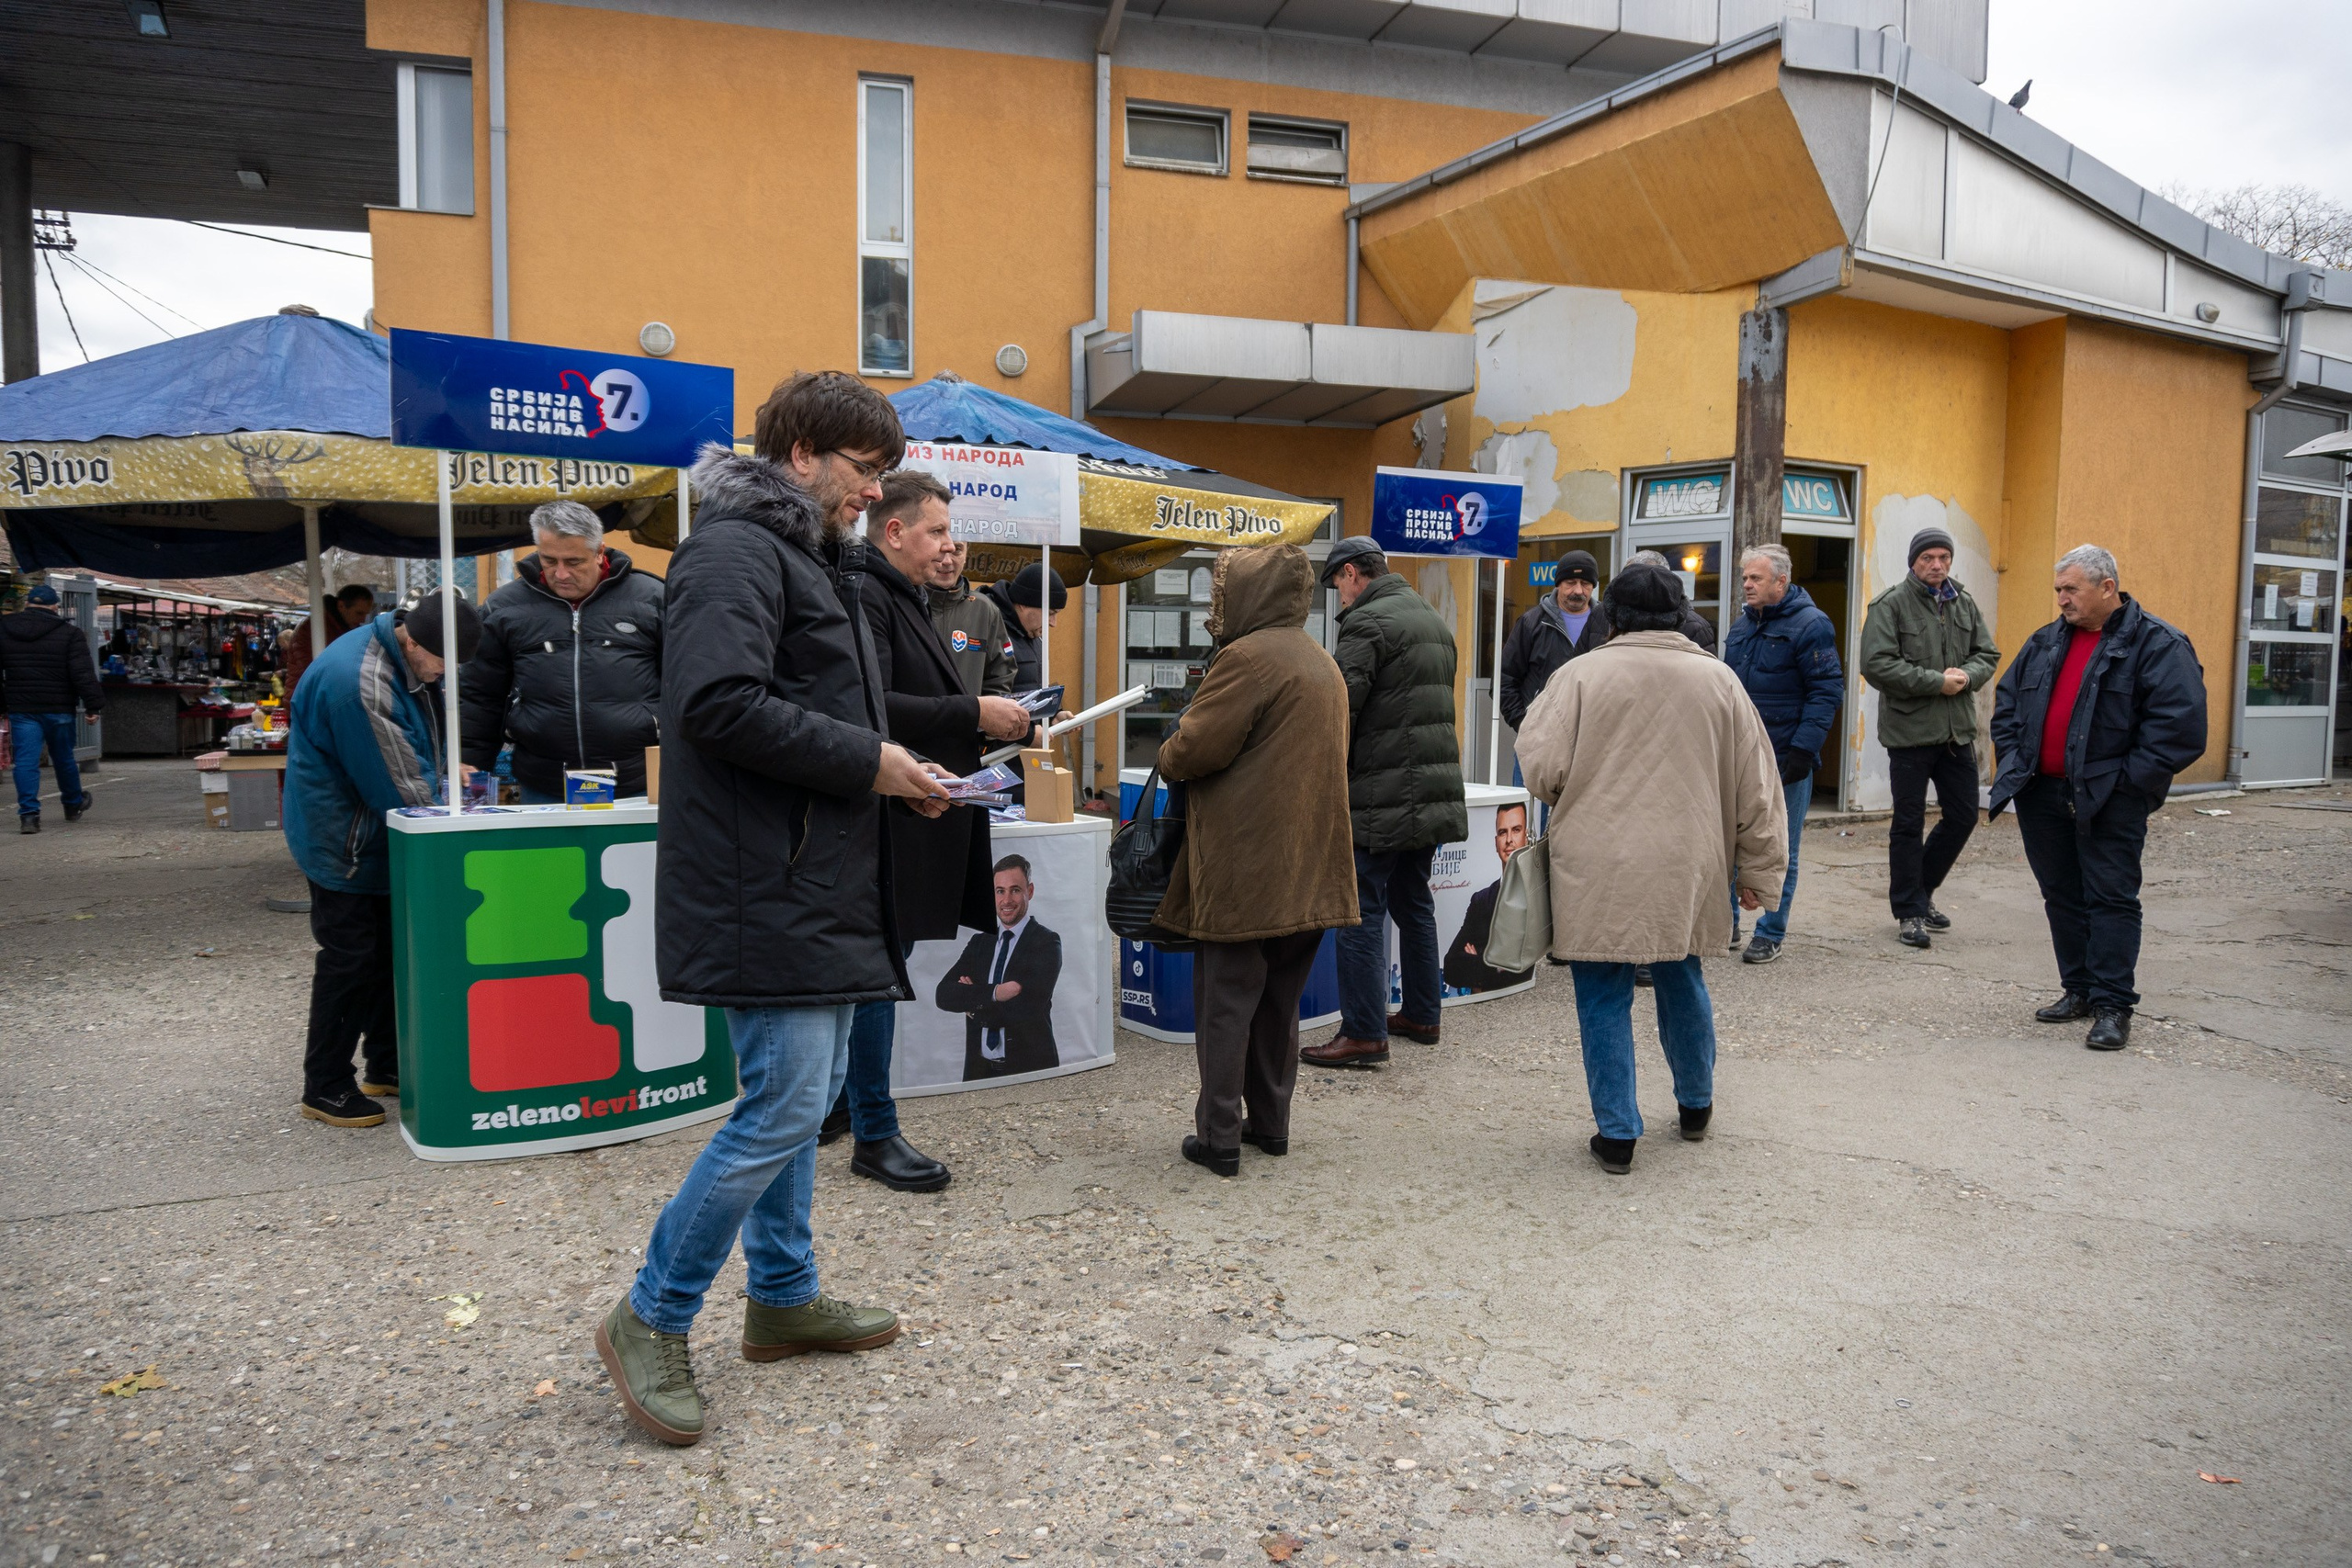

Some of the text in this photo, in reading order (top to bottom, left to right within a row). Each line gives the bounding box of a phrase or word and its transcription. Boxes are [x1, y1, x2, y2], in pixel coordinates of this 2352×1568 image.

[490, 387, 583, 410] СРБИЈА
[606, 382, 639, 422] 7.
[490, 401, 583, 423] ПРОТИВ
[490, 416, 589, 438] НАСИЉА
[906, 445, 1025, 468] ИЗ НАРОДА
[6, 449, 110, 495] Pivo
[448, 451, 631, 493] Jelen Pivo
[949, 481, 1018, 502] НАРОД
[1656, 479, 1715, 515] WC
[1784, 479, 1833, 512] WC
[1151, 495, 1282, 537] Jelen Pivo
[1406, 508, 1453, 521] СРБИЈА
[1406, 519, 1453, 531] ПРОТИВ
[1465, 502, 1482, 528] 7.
[950, 518, 1019, 539] НАРОД
[1406, 529, 1454, 541] НАСИЉА
[579, 781, 600, 790] ASK
[1441, 849, 1467, 862] ЛИЦЕ
[1432, 861, 1461, 877] БИЈЕ
[1123, 991, 1150, 1005] SSP.RS
[470, 1075, 707, 1132] zelenolevifront
